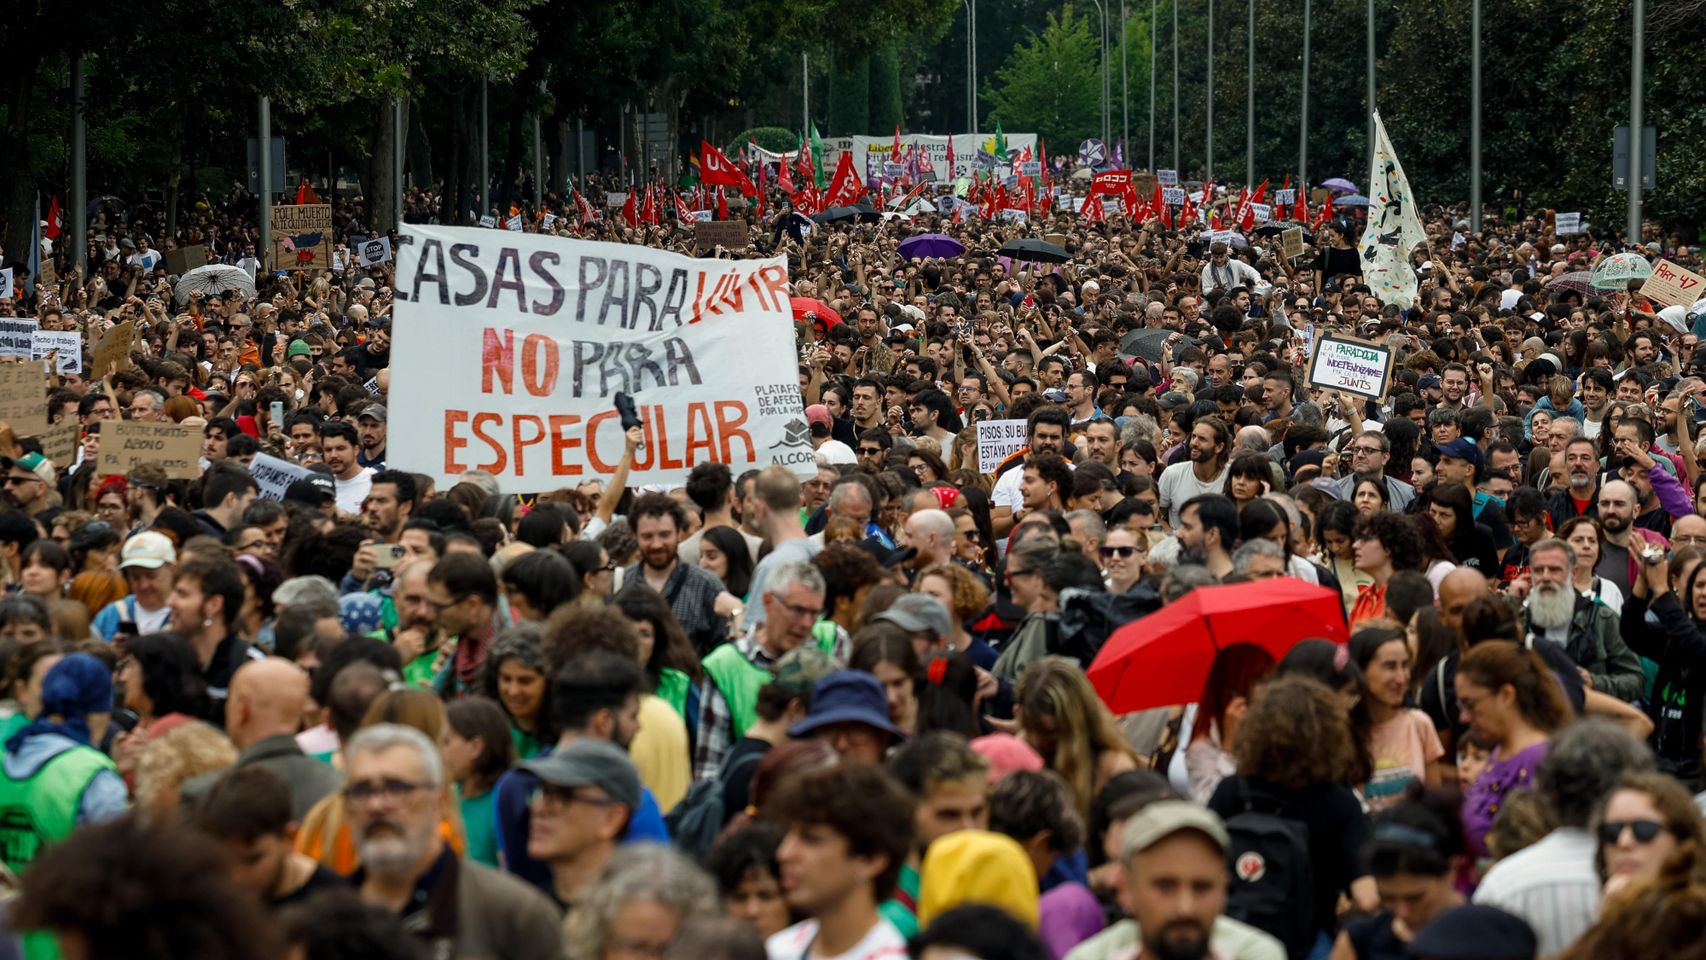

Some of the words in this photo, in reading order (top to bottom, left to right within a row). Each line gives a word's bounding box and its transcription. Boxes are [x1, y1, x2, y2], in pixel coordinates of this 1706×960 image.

[274, 207, 294, 220] POLI
[298, 206, 331, 219] MUERTO
[287, 219, 307, 230] QUITA
[366, 244, 383, 254] STOP
[394, 234, 565, 317] CASAS
[576, 256, 688, 331] PARA
[1679, 274, 1699, 290] 47
[1335, 343, 1379, 363] PARADOJA
[482, 327, 559, 397] NO
[571, 337, 702, 398] PARA
[1338, 376, 1371, 390] JUNTS
[758, 396, 772, 408] DE
[773, 395, 802, 407] AFECT
[760, 407, 777, 416] POR
[777, 407, 789, 415] LA
[790, 406, 803, 415] HIP
[444, 400, 756, 477] ESPECULAR
[980, 425, 1004, 439] PISOS:
[1005, 425, 1015, 438] SU
[123, 437, 165, 450] ABONO
[771, 451, 815, 466] ALCOR
[981, 461, 988, 470] Es
